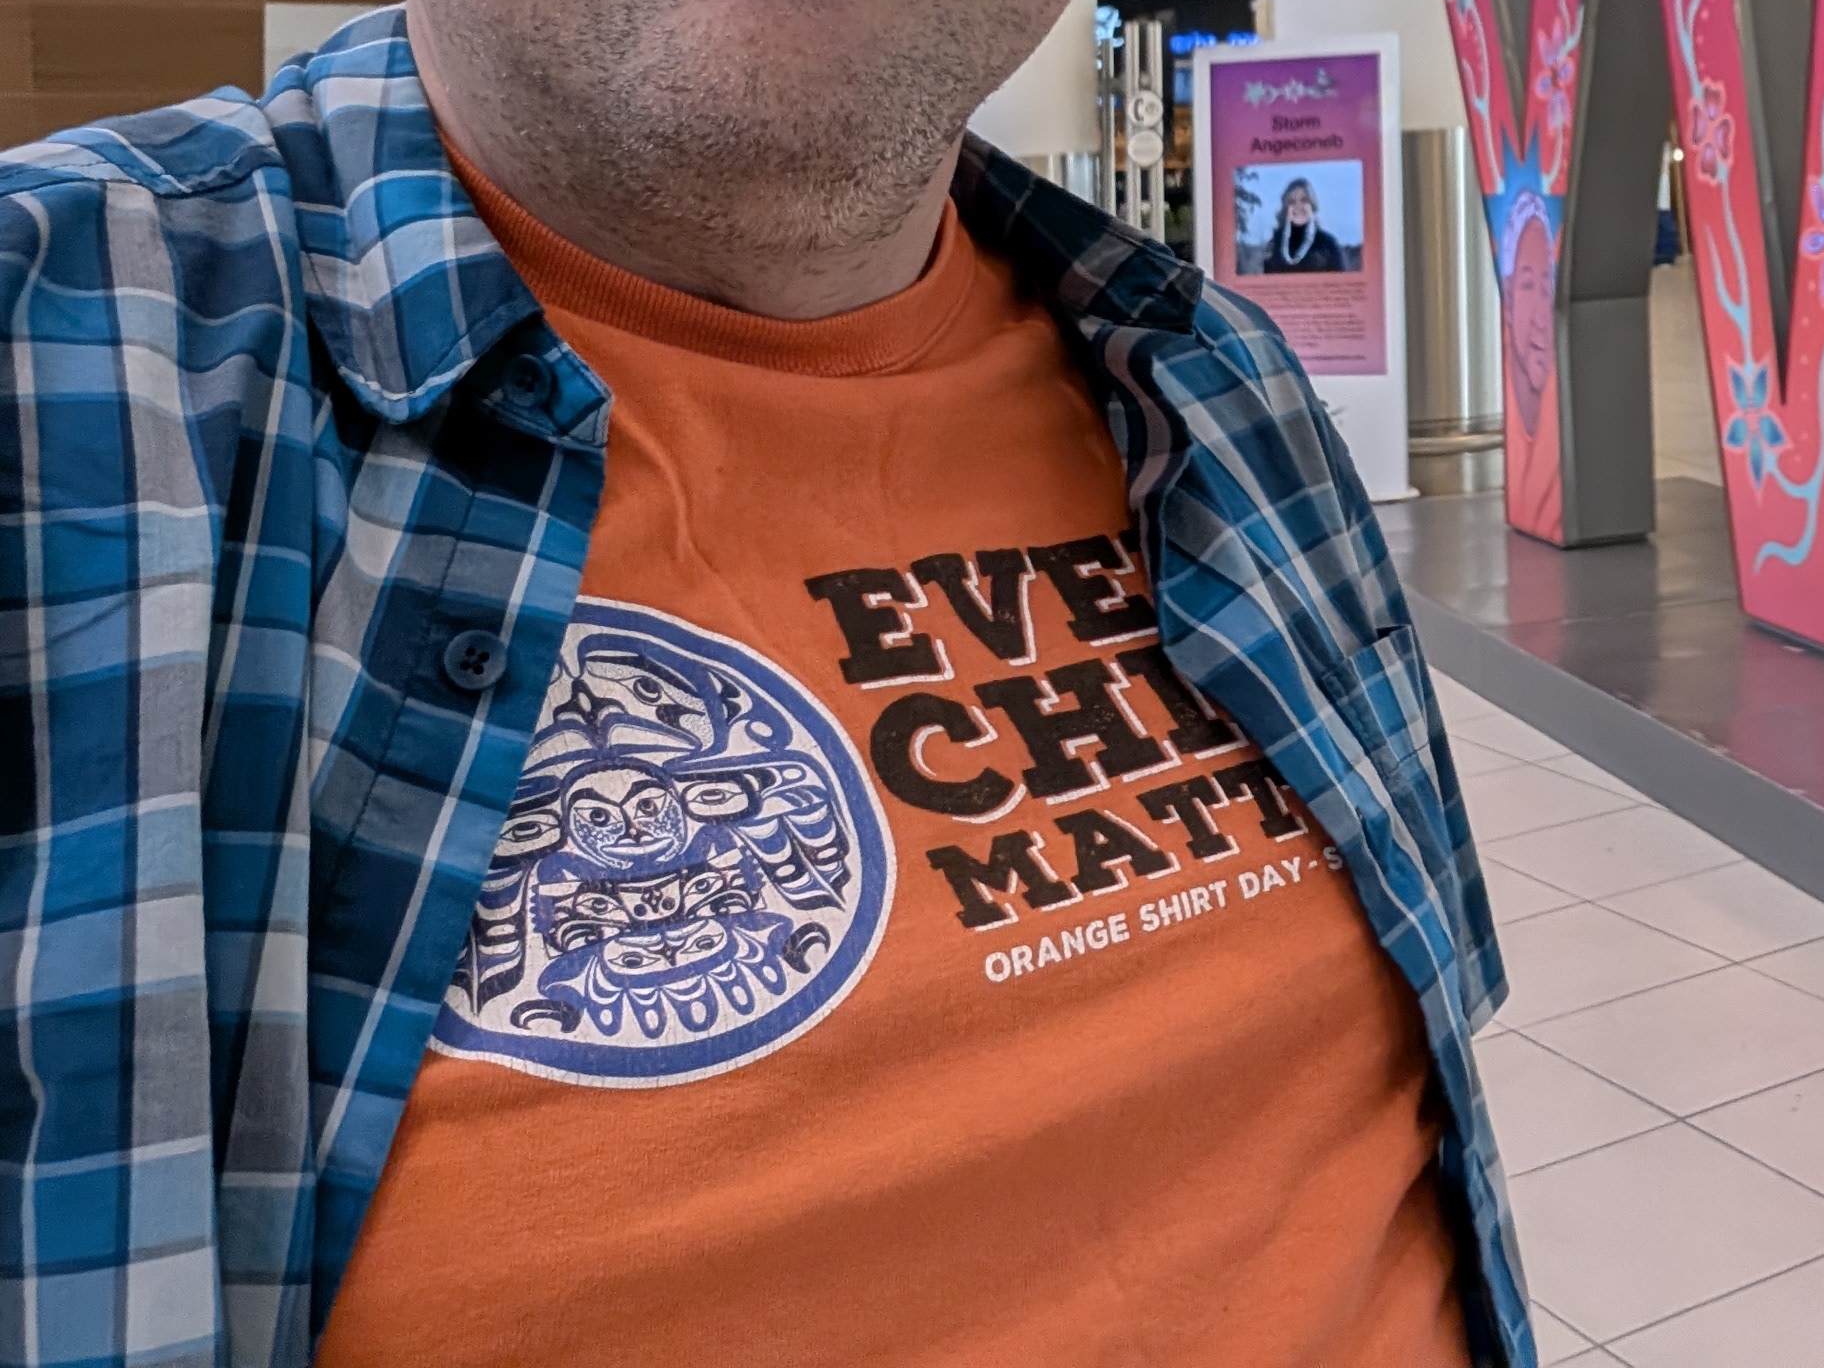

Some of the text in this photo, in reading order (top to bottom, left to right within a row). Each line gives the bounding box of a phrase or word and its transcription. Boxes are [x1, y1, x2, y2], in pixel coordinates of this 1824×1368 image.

[804, 527, 1159, 689] EVE
[984, 913, 1131, 983] ORANGE
[1138, 880, 1228, 933] SHIRT
[1237, 856, 1301, 900] DAY
